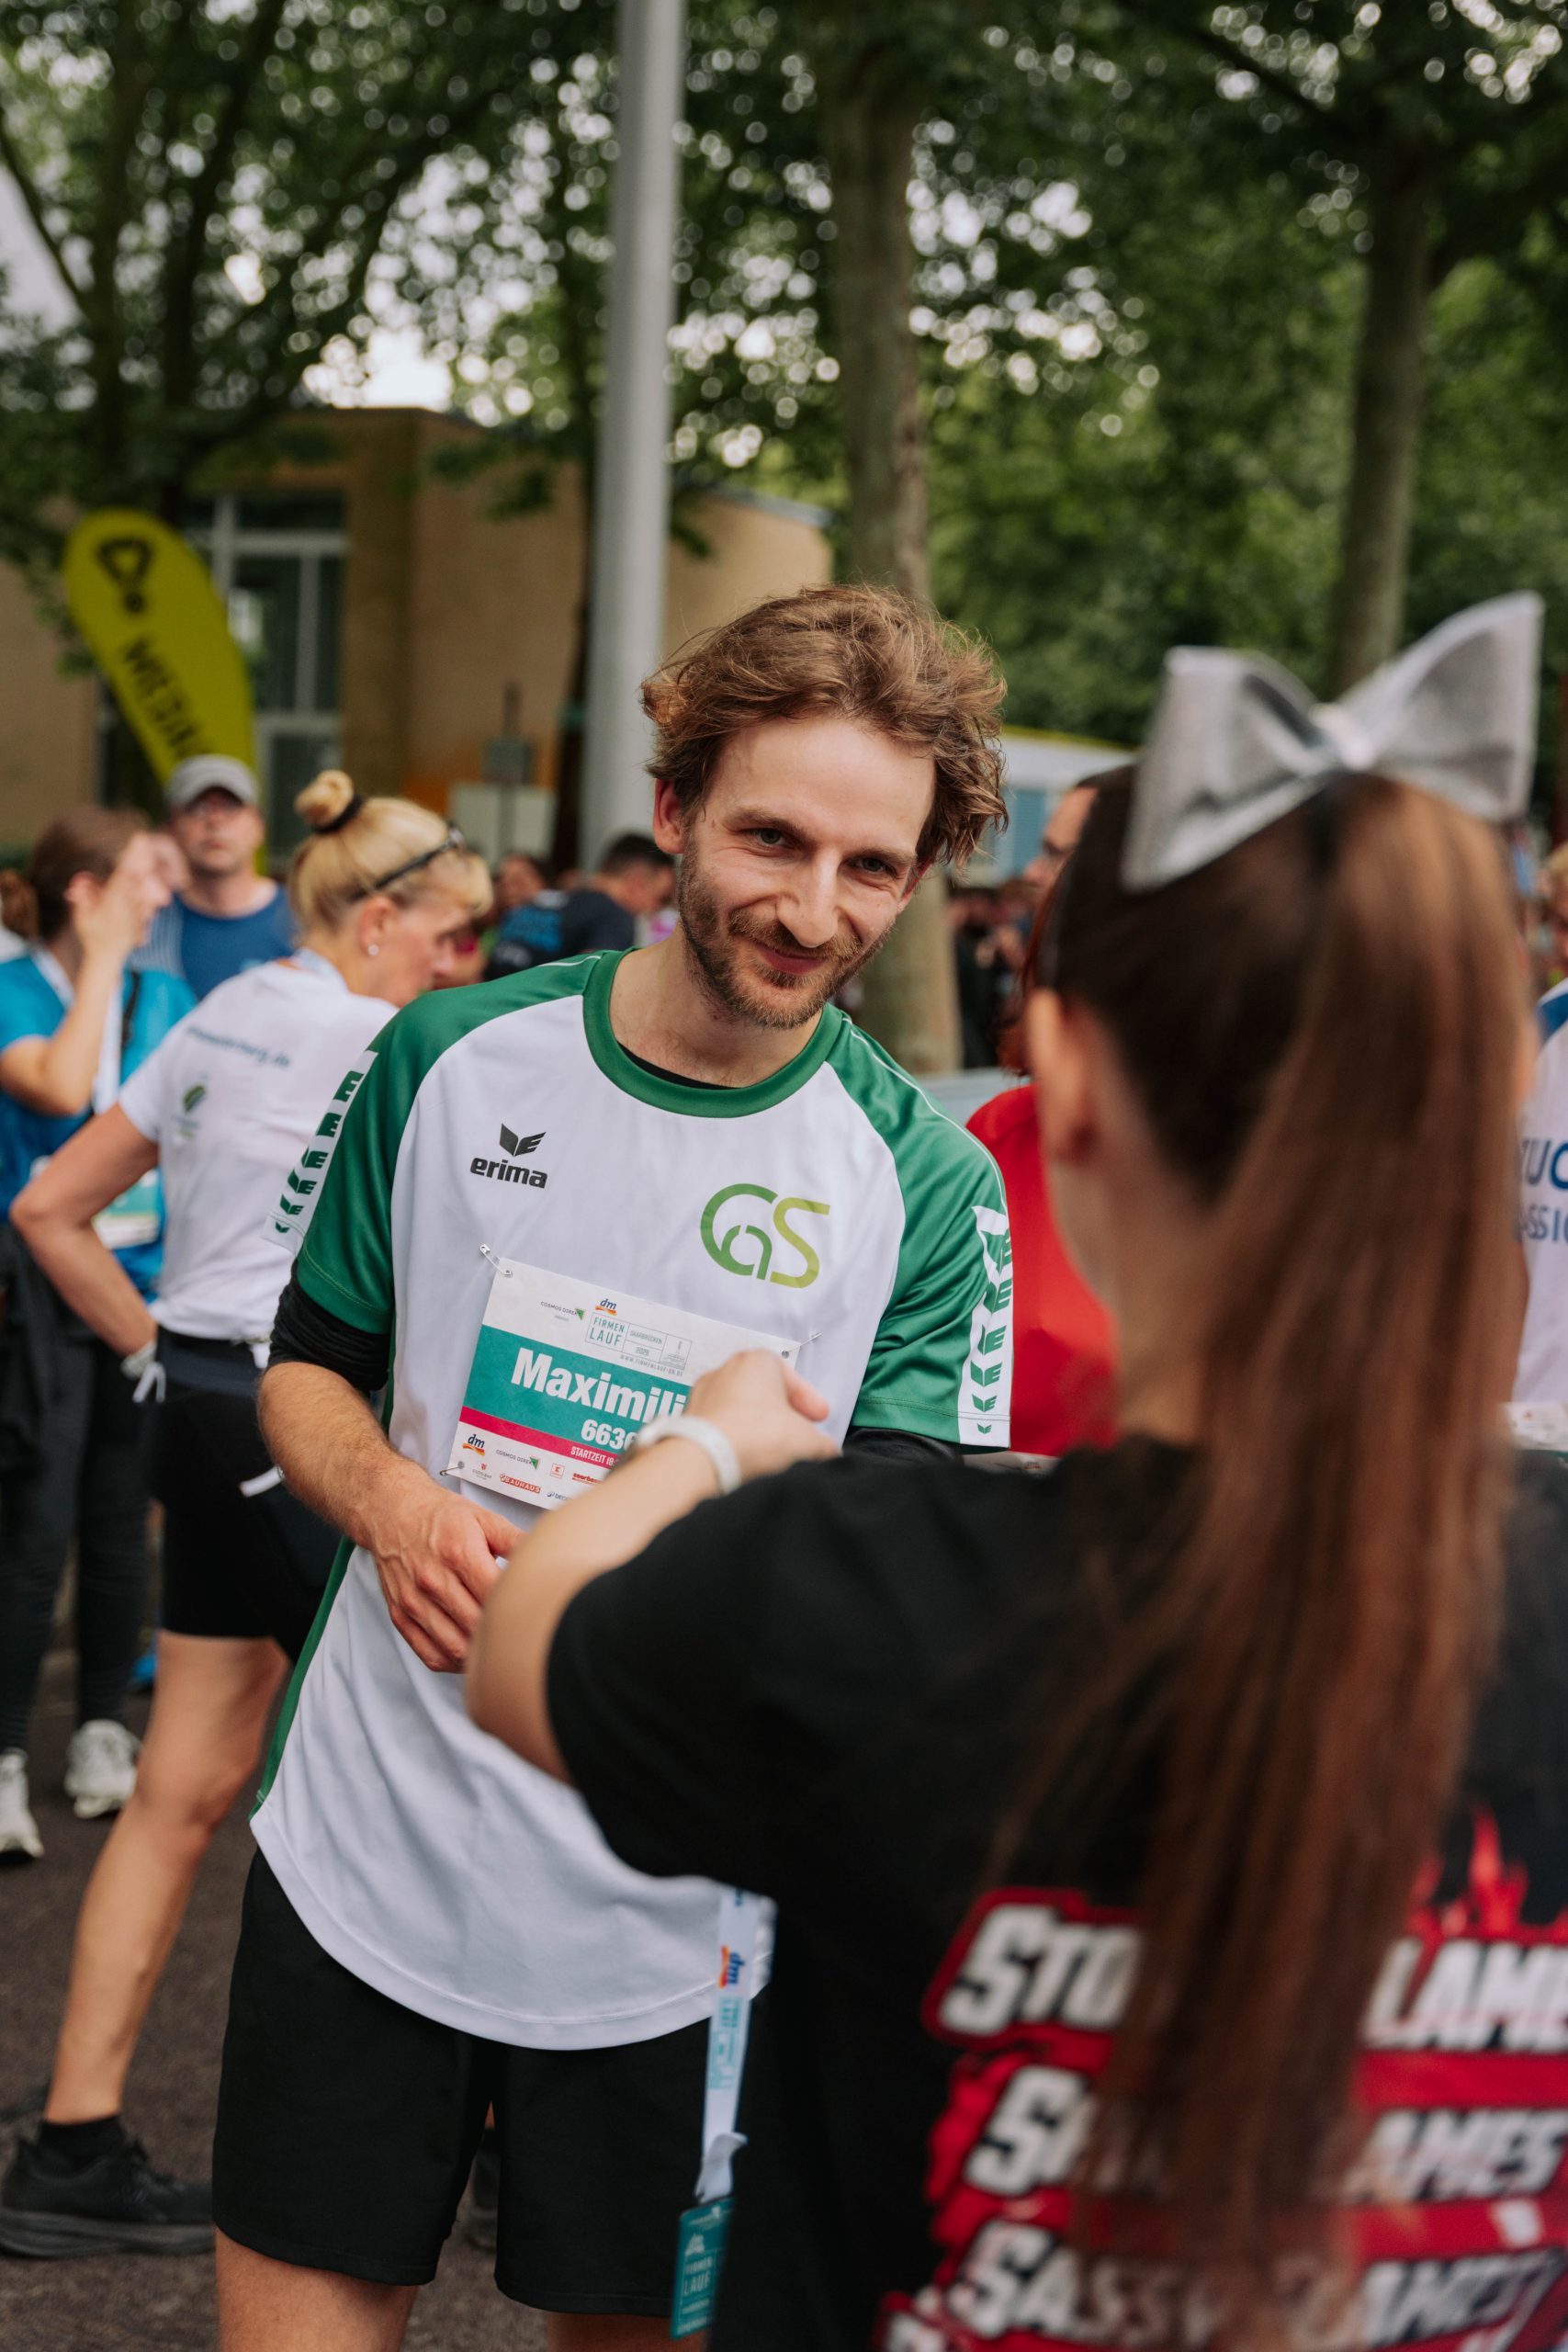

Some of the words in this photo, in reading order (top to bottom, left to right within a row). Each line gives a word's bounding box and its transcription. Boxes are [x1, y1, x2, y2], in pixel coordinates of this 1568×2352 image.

[469, 1157, 548, 1189] erima
[540, 1301, 562, 1312] COSMOS
[600, 1298, 617, 1310] dm
[593, 1317, 625, 1332] FIRMEN
[589, 1327, 623, 1346] LAUF
[468, 1434, 485, 1449] dm
[495, 1449, 516, 1461] COSMOS
[570, 1446, 606, 1464] STARTZEIT
[504, 1476, 540, 1493] BAUHAUS
